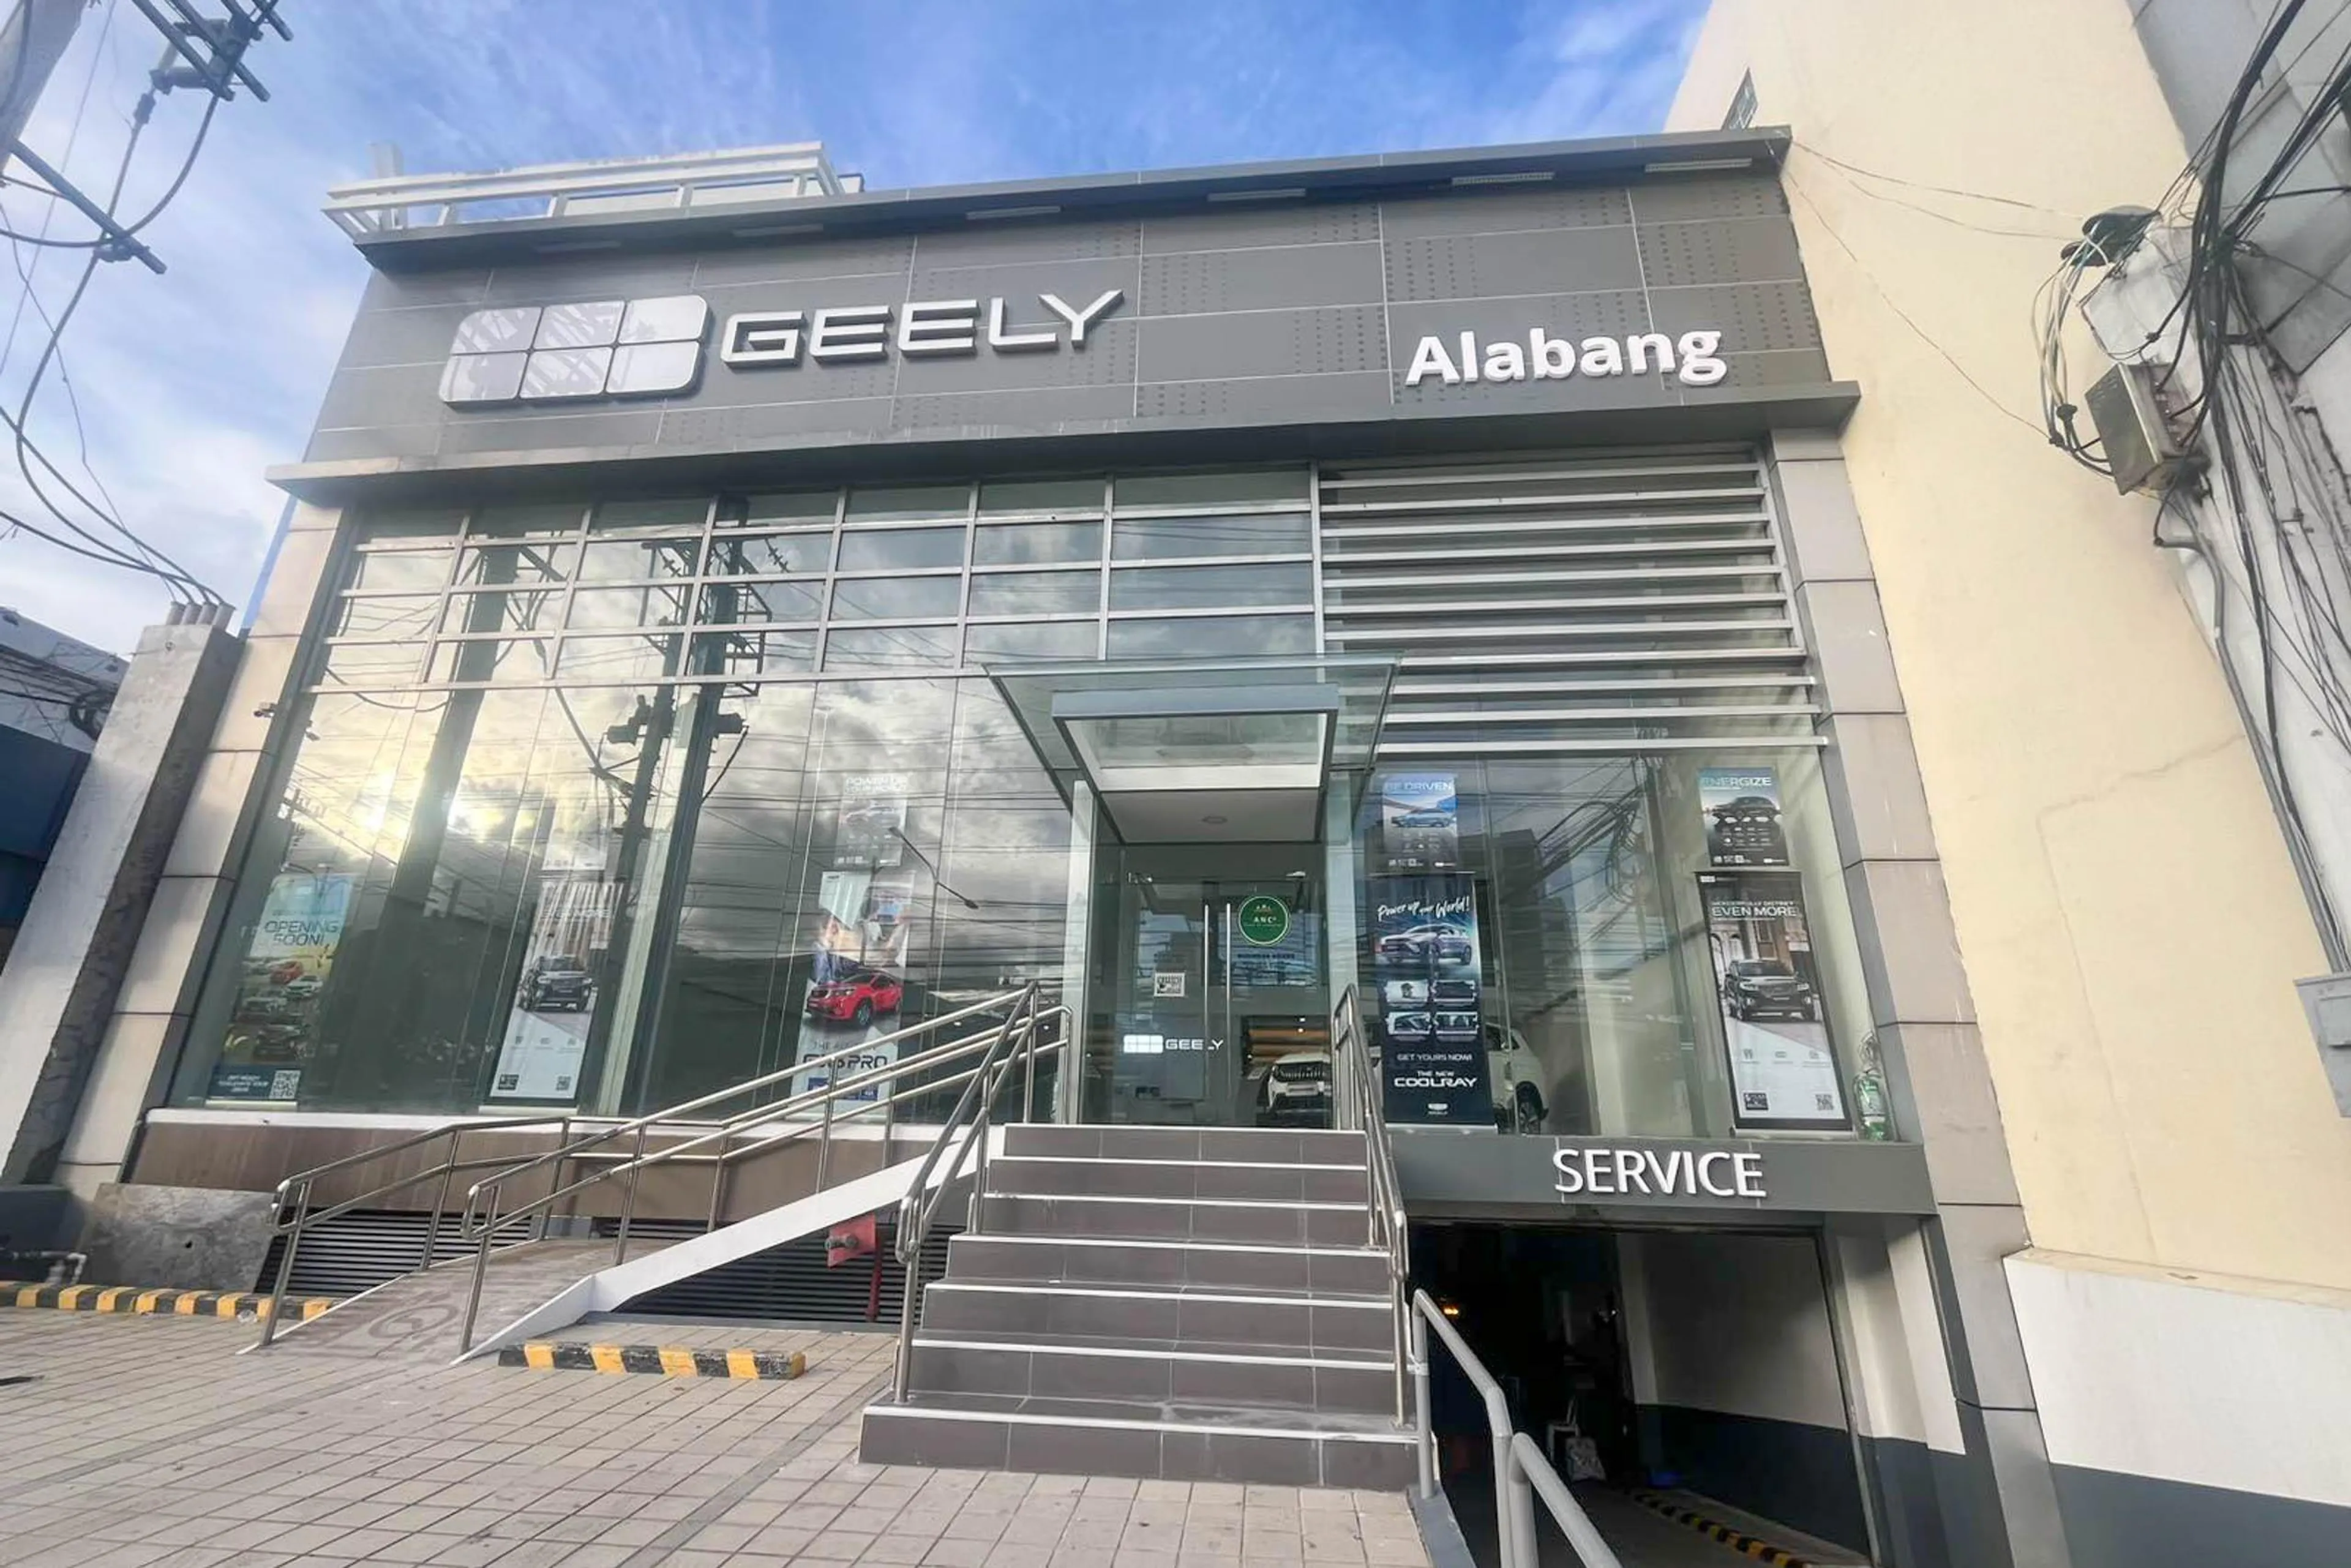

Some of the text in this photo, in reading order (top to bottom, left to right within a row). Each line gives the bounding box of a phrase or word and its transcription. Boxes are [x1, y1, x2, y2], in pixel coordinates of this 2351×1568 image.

[721, 289, 1124, 367] GEELY
[1405, 328, 1727, 385] Alabang
[1404, 782, 1452, 791] DRIVEN
[1712, 906, 1799, 917] EVEN MORE
[264, 920, 340, 933] OPENING
[273, 932, 325, 946] SOON!
[848, 1055, 888, 1070] PRO
[1394, 1078, 1477, 1087] COOLRAY
[1552, 1148, 1767, 1198] SERVICE
